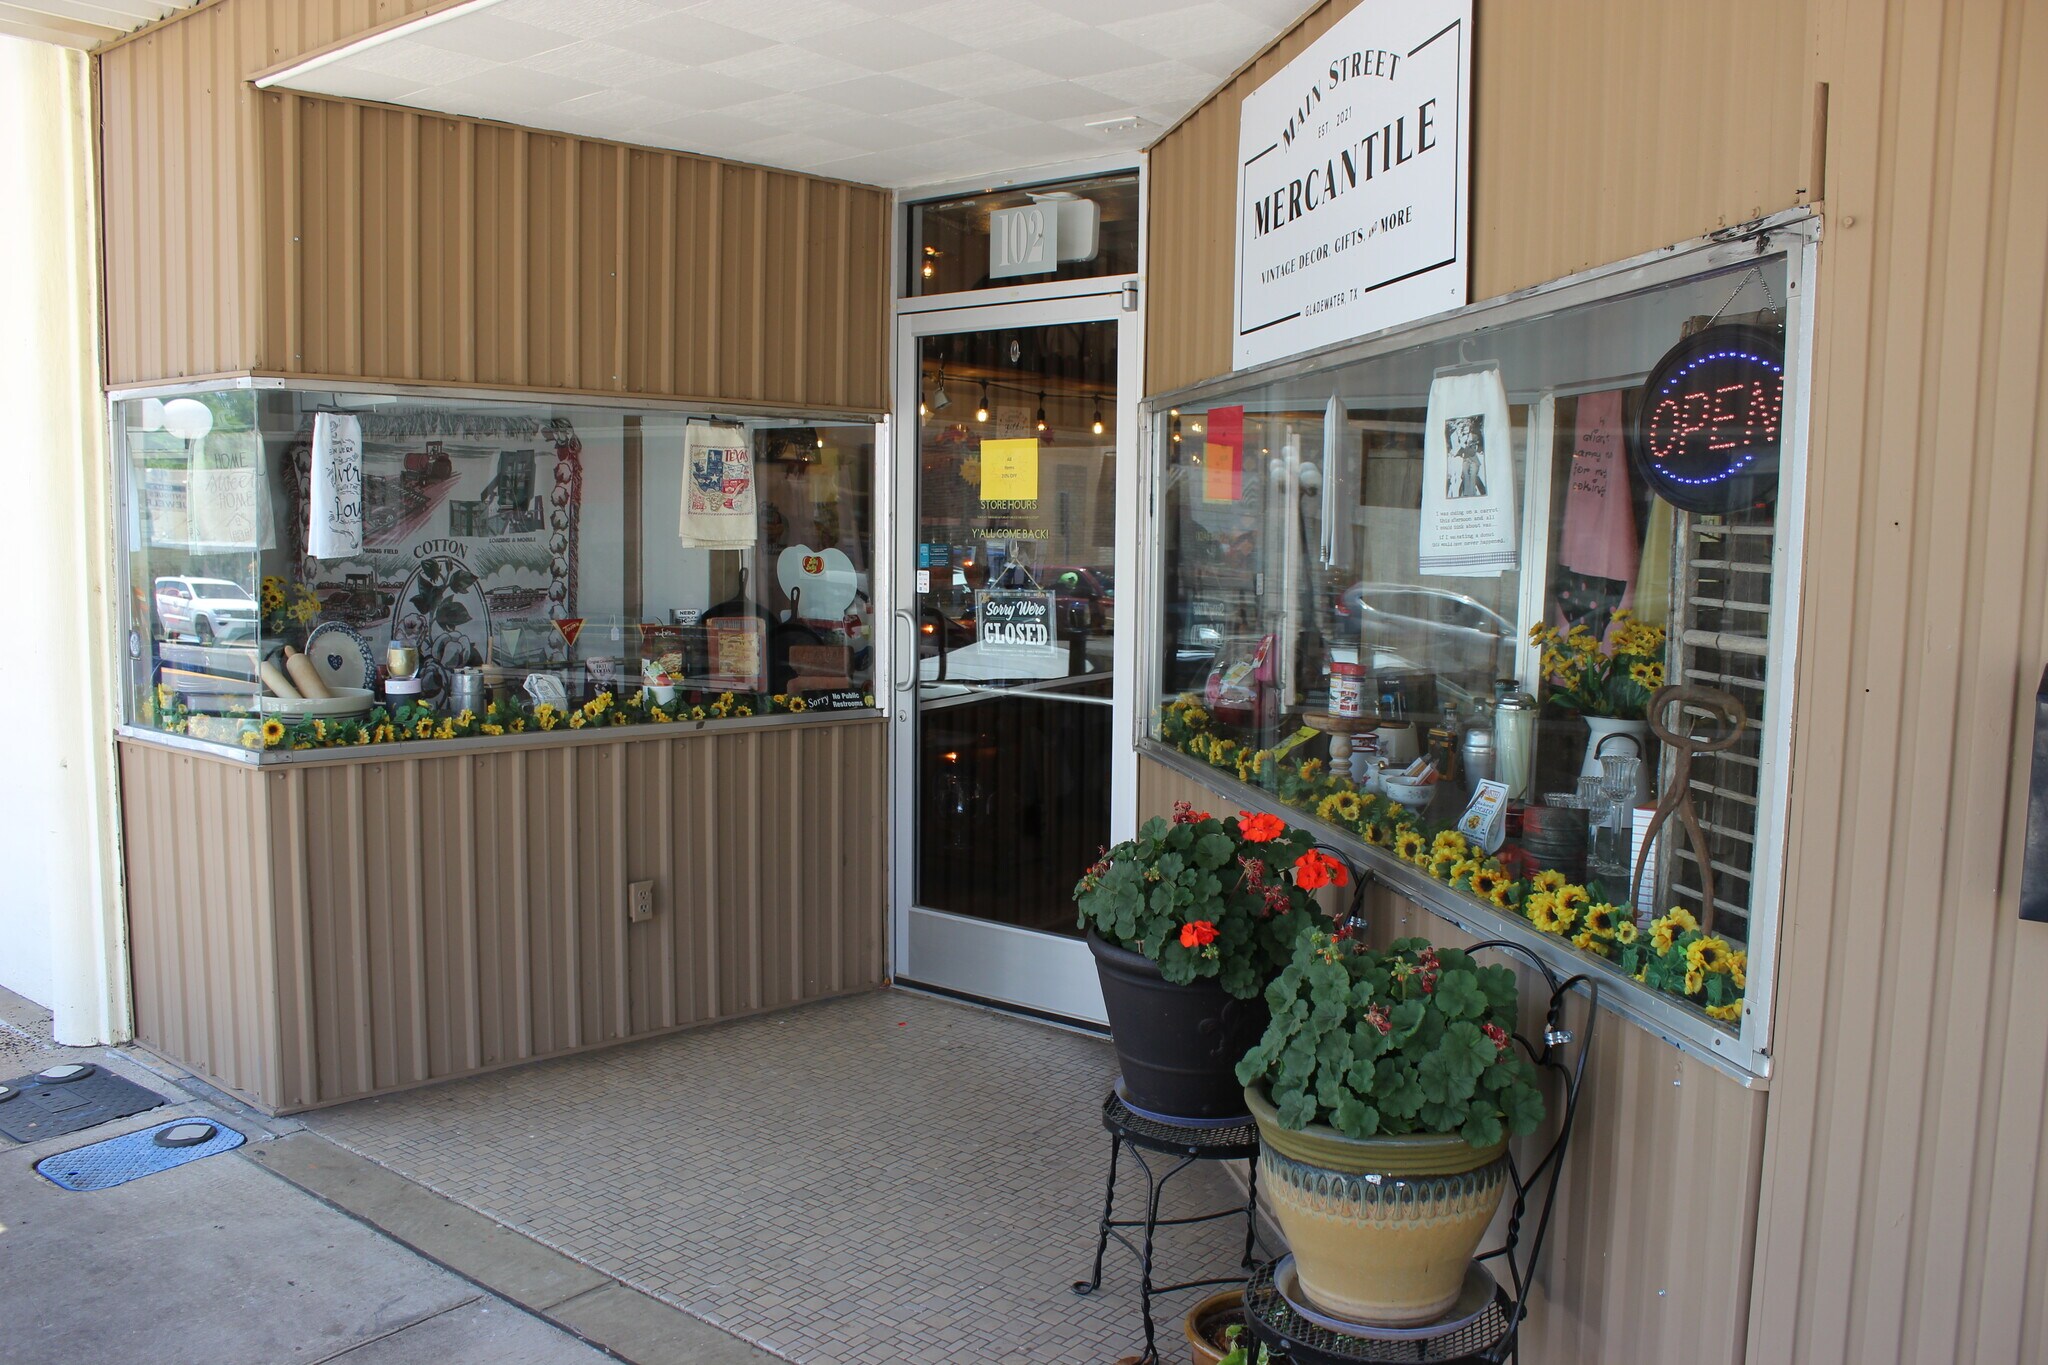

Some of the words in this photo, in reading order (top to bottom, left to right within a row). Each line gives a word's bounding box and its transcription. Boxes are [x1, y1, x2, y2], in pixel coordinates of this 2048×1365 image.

[1283, 80, 1321, 153] MAIN
[1329, 50, 1400, 90] STREET
[1318, 122, 1331, 138] EST.
[1336, 106, 1352, 126] 2021
[1254, 98, 1436, 240] MERCANTILE
[999, 209, 1045, 267] 102
[1261, 259, 1296, 285] VINTAGE
[1380, 205, 1412, 235] MORE
[1350, 287, 1358, 301] TX
[1650, 375, 1784, 458] OPEN
[214, 452, 248, 469] HOME
[724, 449, 748, 463] TEXAS
[219, 491, 255, 509] HOME
[981, 500, 1006, 509] STORE
[1008, 500, 1037, 509] HOURS
[972, 529, 996, 539] Y'ALL
[997, 529, 1020, 539] COME
[1022, 529, 1049, 539] BACK!
[413, 539, 469, 559] COTTON
[986, 601, 1015, 621] Sorry
[984, 622, 1048, 645] CLOSED
[808, 695, 829, 708] Sorry
[841, 692, 860, 700] Public
